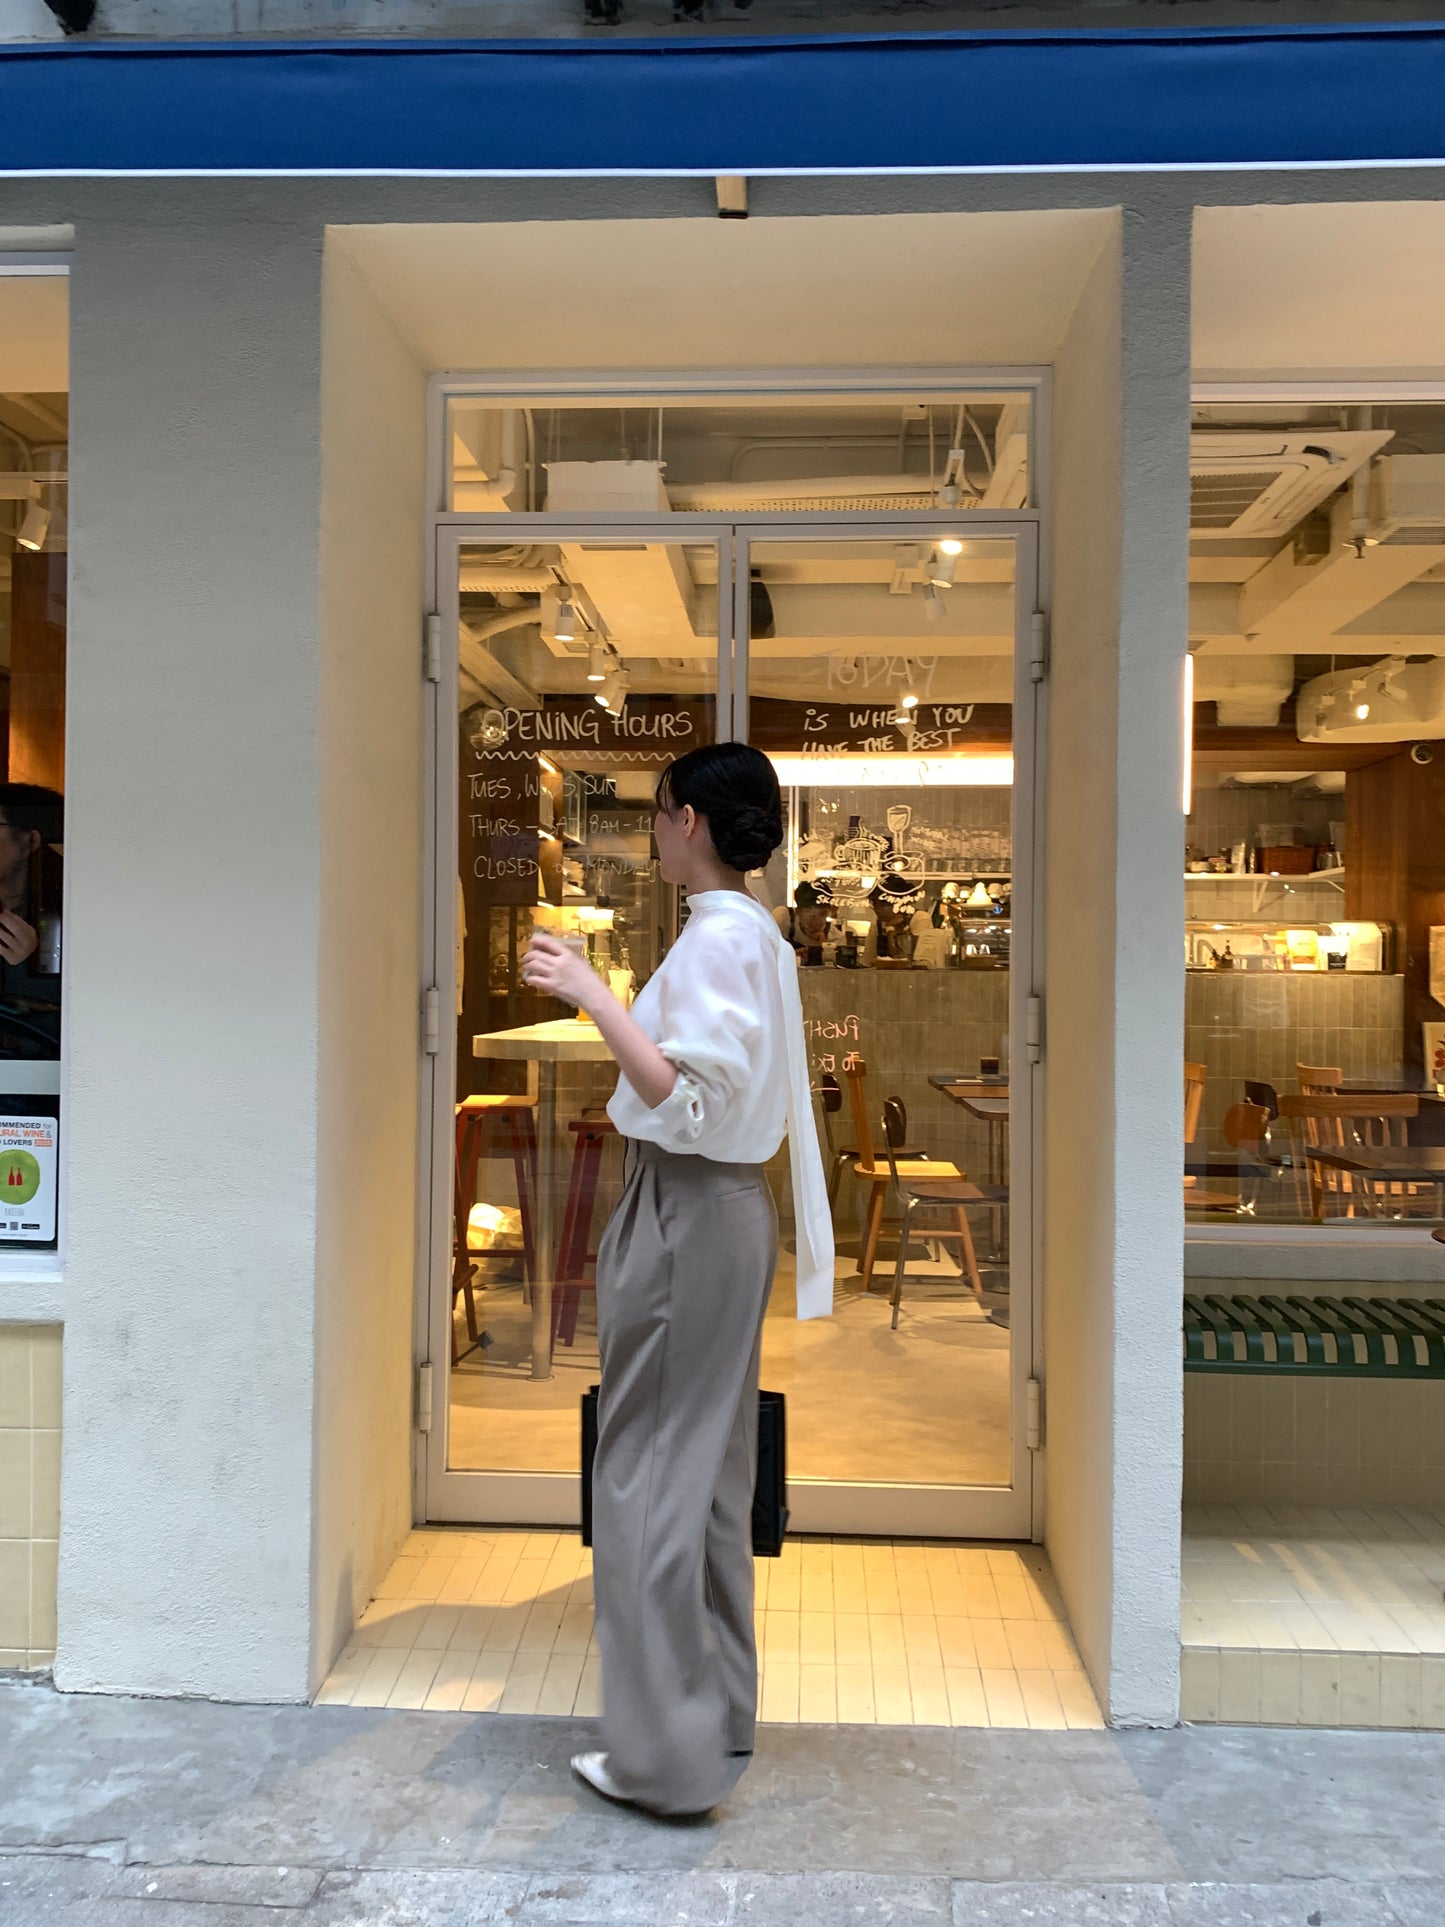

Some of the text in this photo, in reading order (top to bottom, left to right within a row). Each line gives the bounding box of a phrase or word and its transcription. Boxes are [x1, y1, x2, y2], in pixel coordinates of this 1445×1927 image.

[849, 709, 918, 729] WHEN
[932, 703, 975, 727] YOU
[801, 727, 962, 760] HAVE THE BEST
[469, 814, 520, 838] THURS
[474, 855, 539, 880] CLOSED
[3, 1138, 33, 1146] LOVERS
